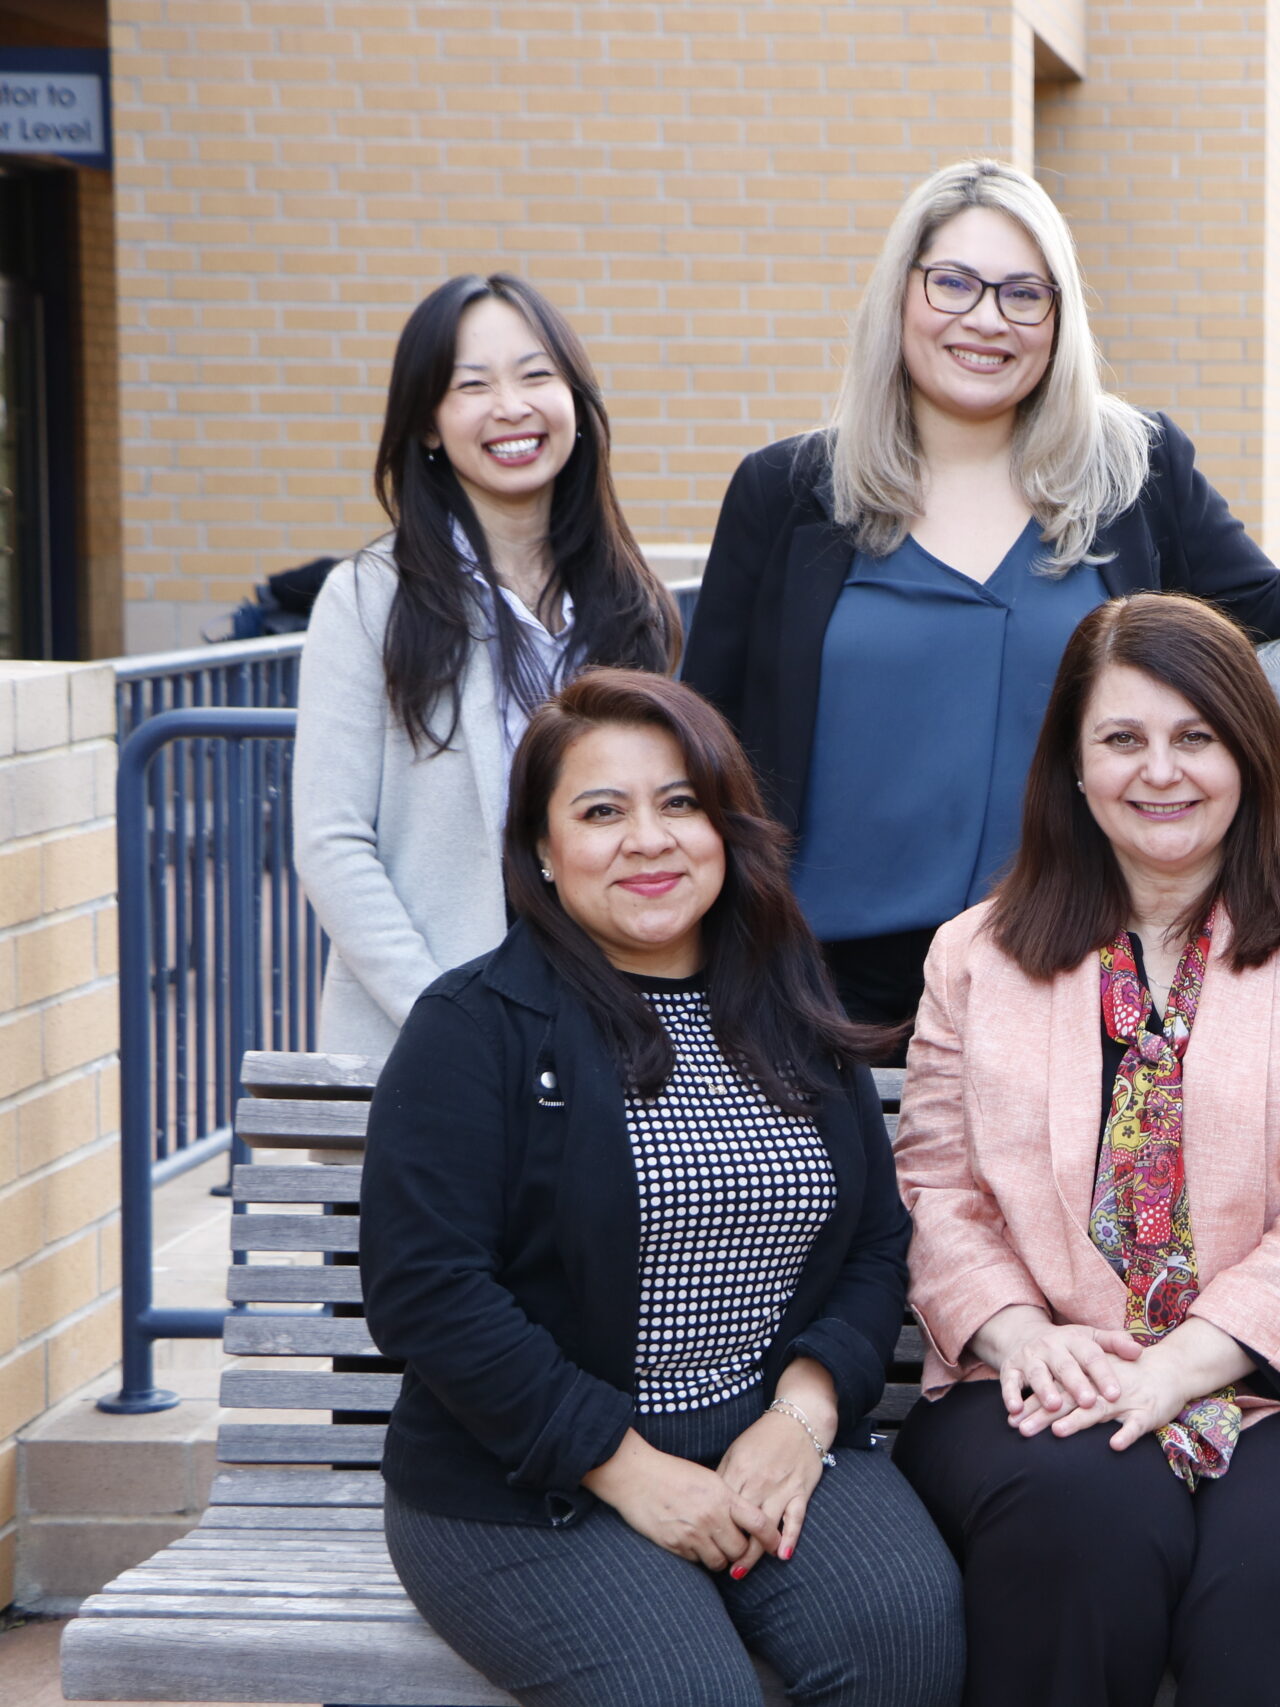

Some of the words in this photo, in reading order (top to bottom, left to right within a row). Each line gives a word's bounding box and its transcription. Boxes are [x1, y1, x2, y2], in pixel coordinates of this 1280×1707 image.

[0, 81, 38, 107] tor
[47, 82, 77, 108] to
[19, 116, 92, 142] Level
